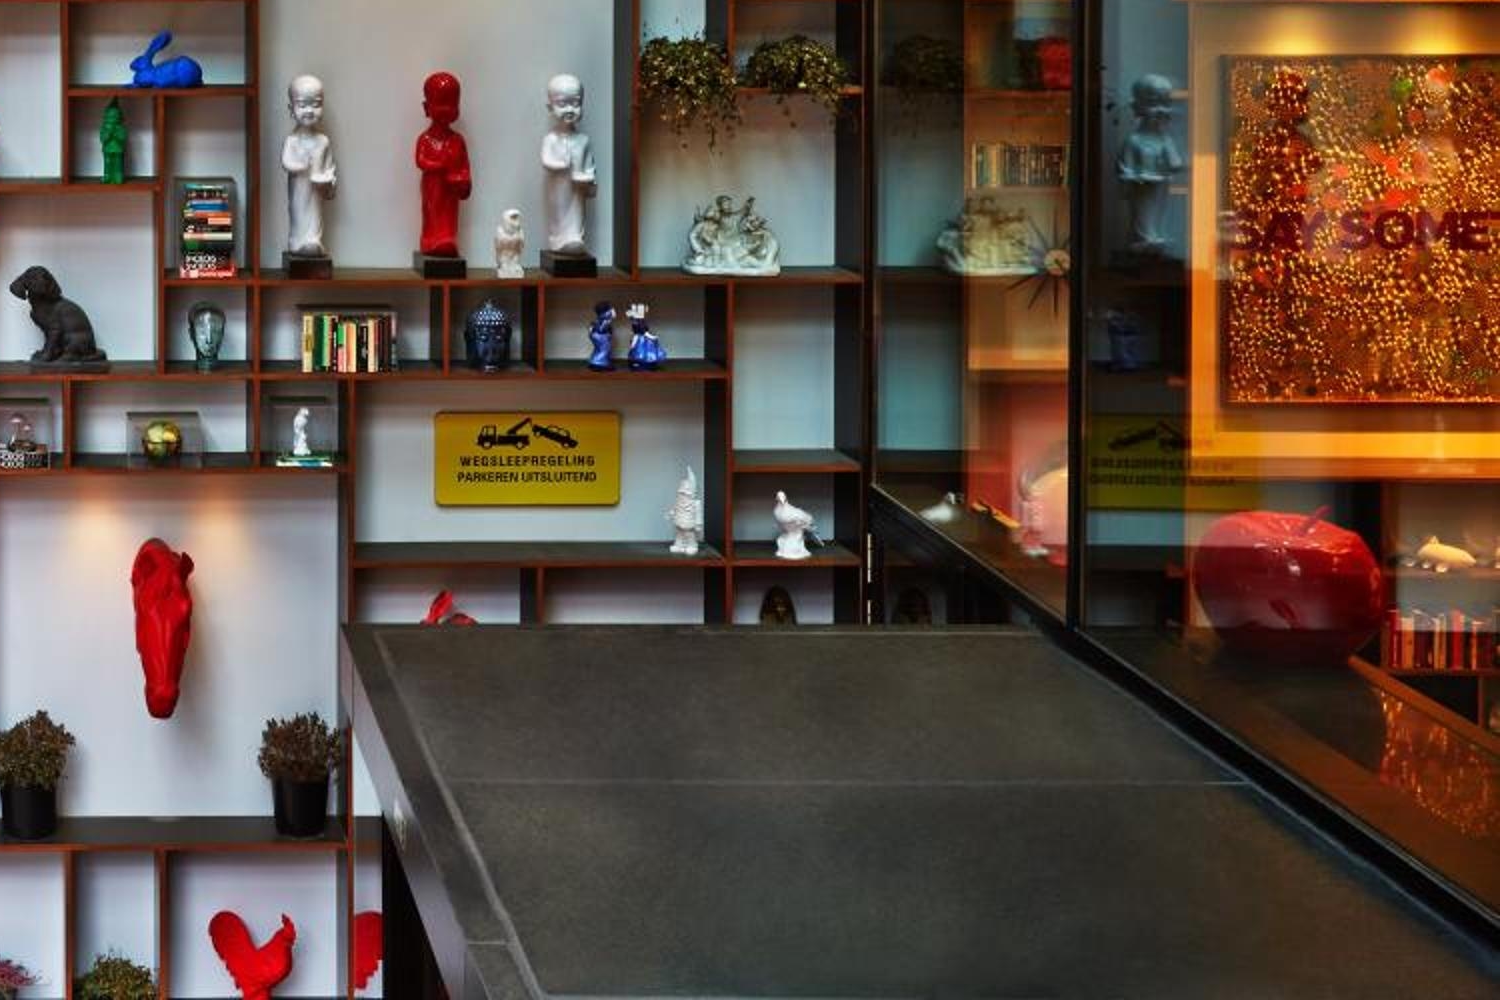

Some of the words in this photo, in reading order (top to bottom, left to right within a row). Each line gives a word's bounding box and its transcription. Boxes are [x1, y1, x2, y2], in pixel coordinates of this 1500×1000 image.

[459, 455, 596, 467] WEGSLEEPREGELING
[457, 471, 519, 483] PARKEREN
[521, 471, 597, 483] UITSLUITEND
